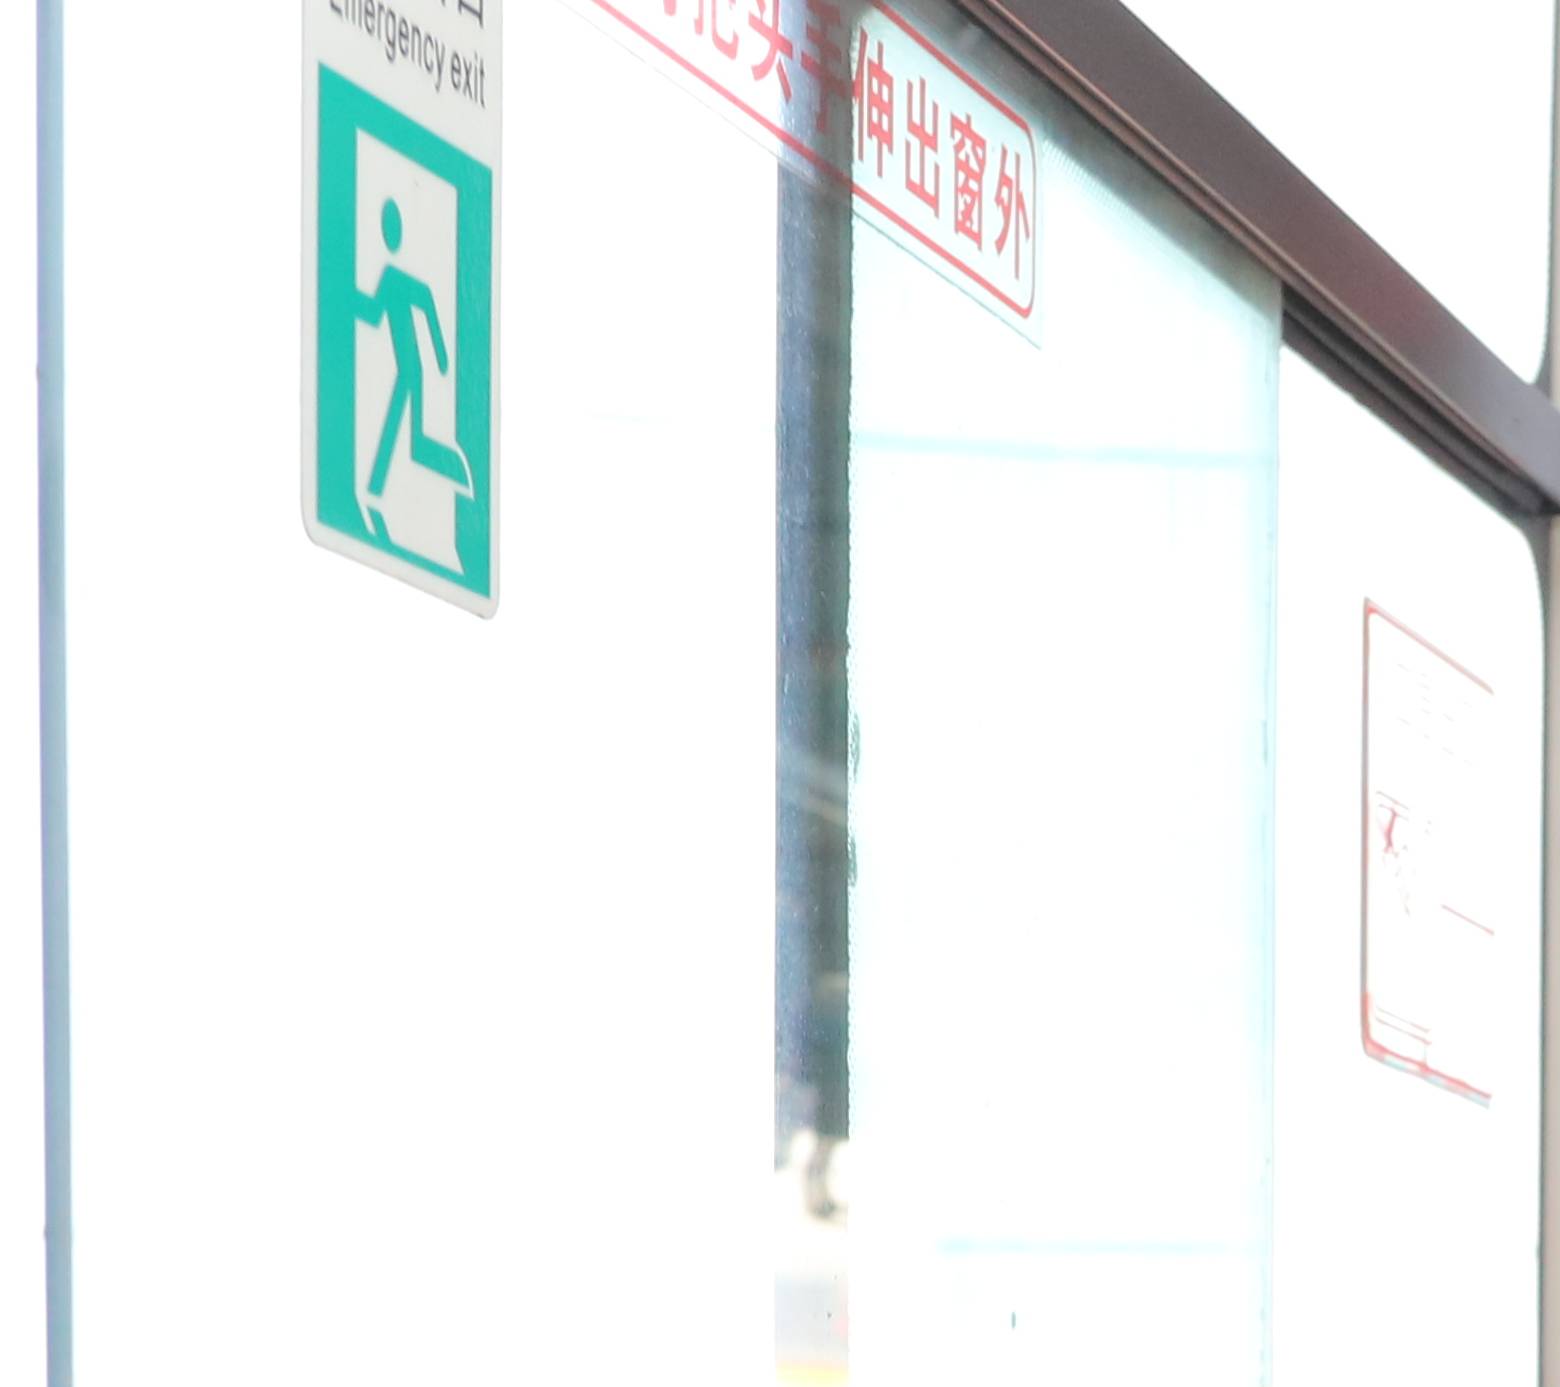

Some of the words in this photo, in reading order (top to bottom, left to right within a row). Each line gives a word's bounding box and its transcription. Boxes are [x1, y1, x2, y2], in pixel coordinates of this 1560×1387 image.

[330, 0, 445, 93] mergency
[451, 50, 486, 109] exit
[663, 0, 1031, 281] 头手伸出窗外
